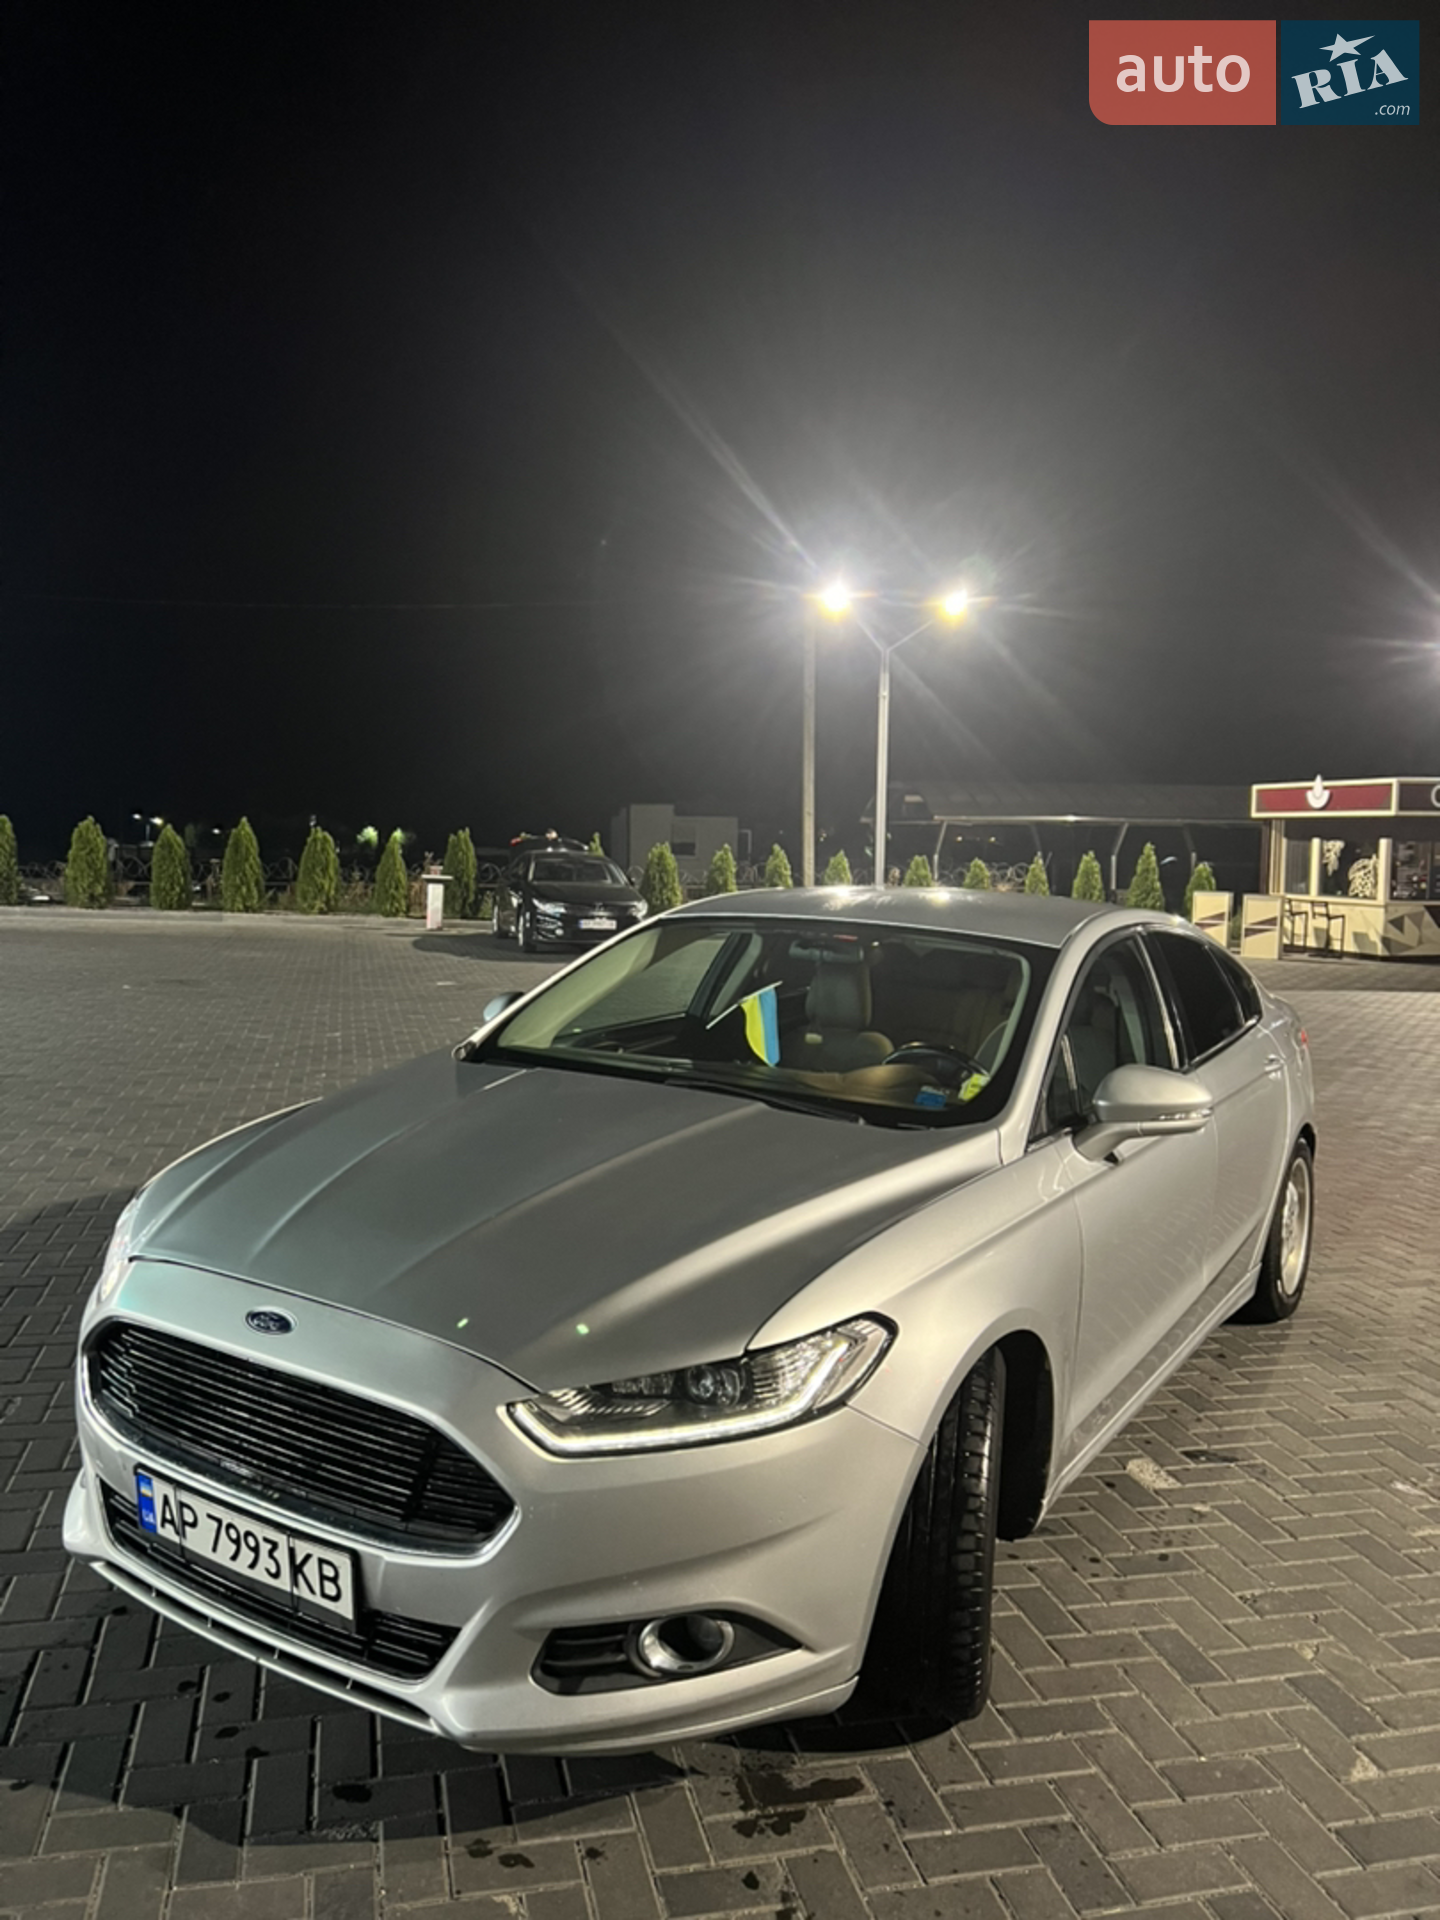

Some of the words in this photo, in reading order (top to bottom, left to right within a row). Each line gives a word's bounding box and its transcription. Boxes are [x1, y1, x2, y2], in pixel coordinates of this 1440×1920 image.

[160, 1494, 198, 1540] AP
[206, 1513, 281, 1580] 7993
[290, 1546, 342, 1602] KB
